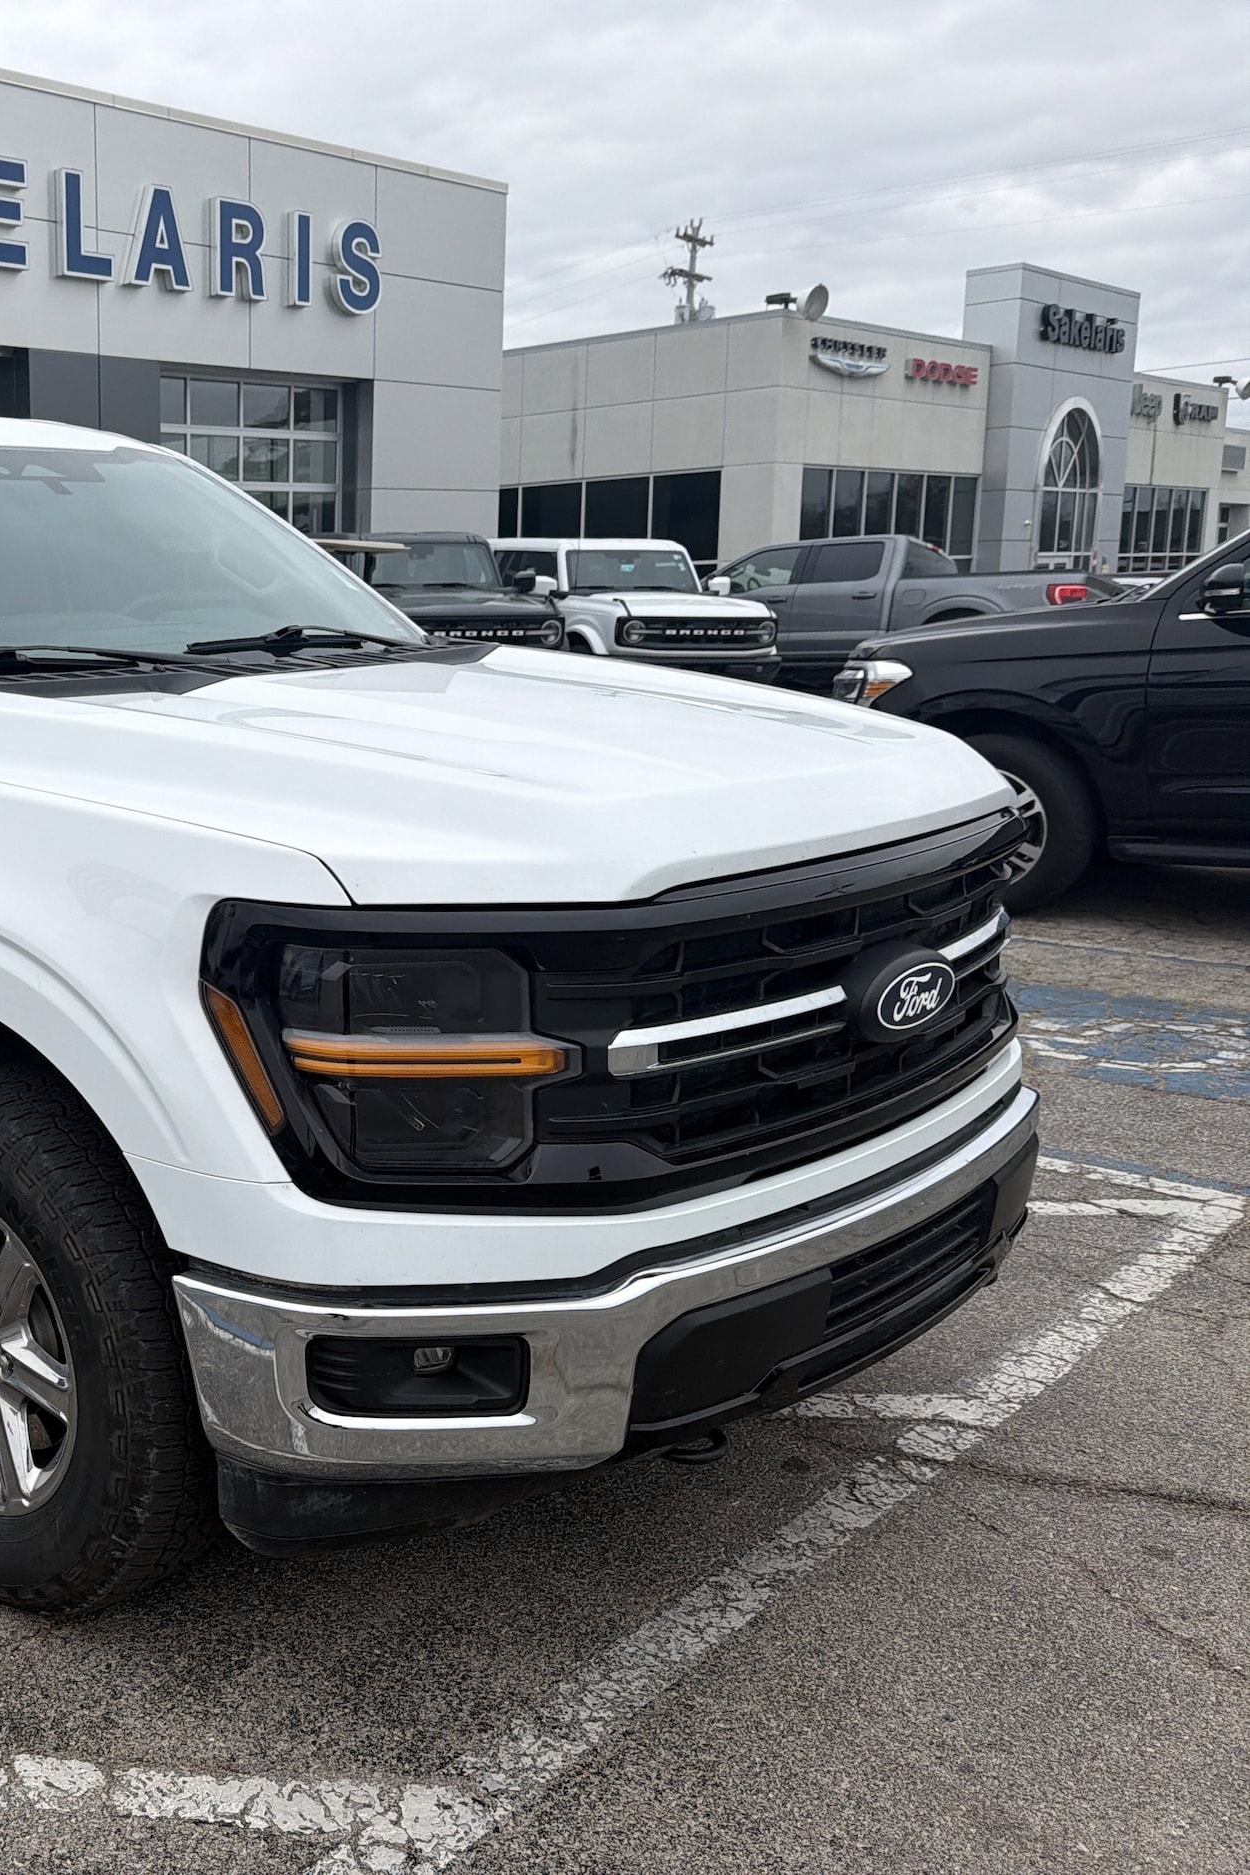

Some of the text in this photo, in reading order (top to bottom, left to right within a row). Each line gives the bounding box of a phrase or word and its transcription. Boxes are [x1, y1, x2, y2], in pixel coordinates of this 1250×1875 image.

[1040, 304, 1126, 353] Sakelaris
[910, 358, 978, 386] DODGE
[893, 972, 943, 1022] Ford
